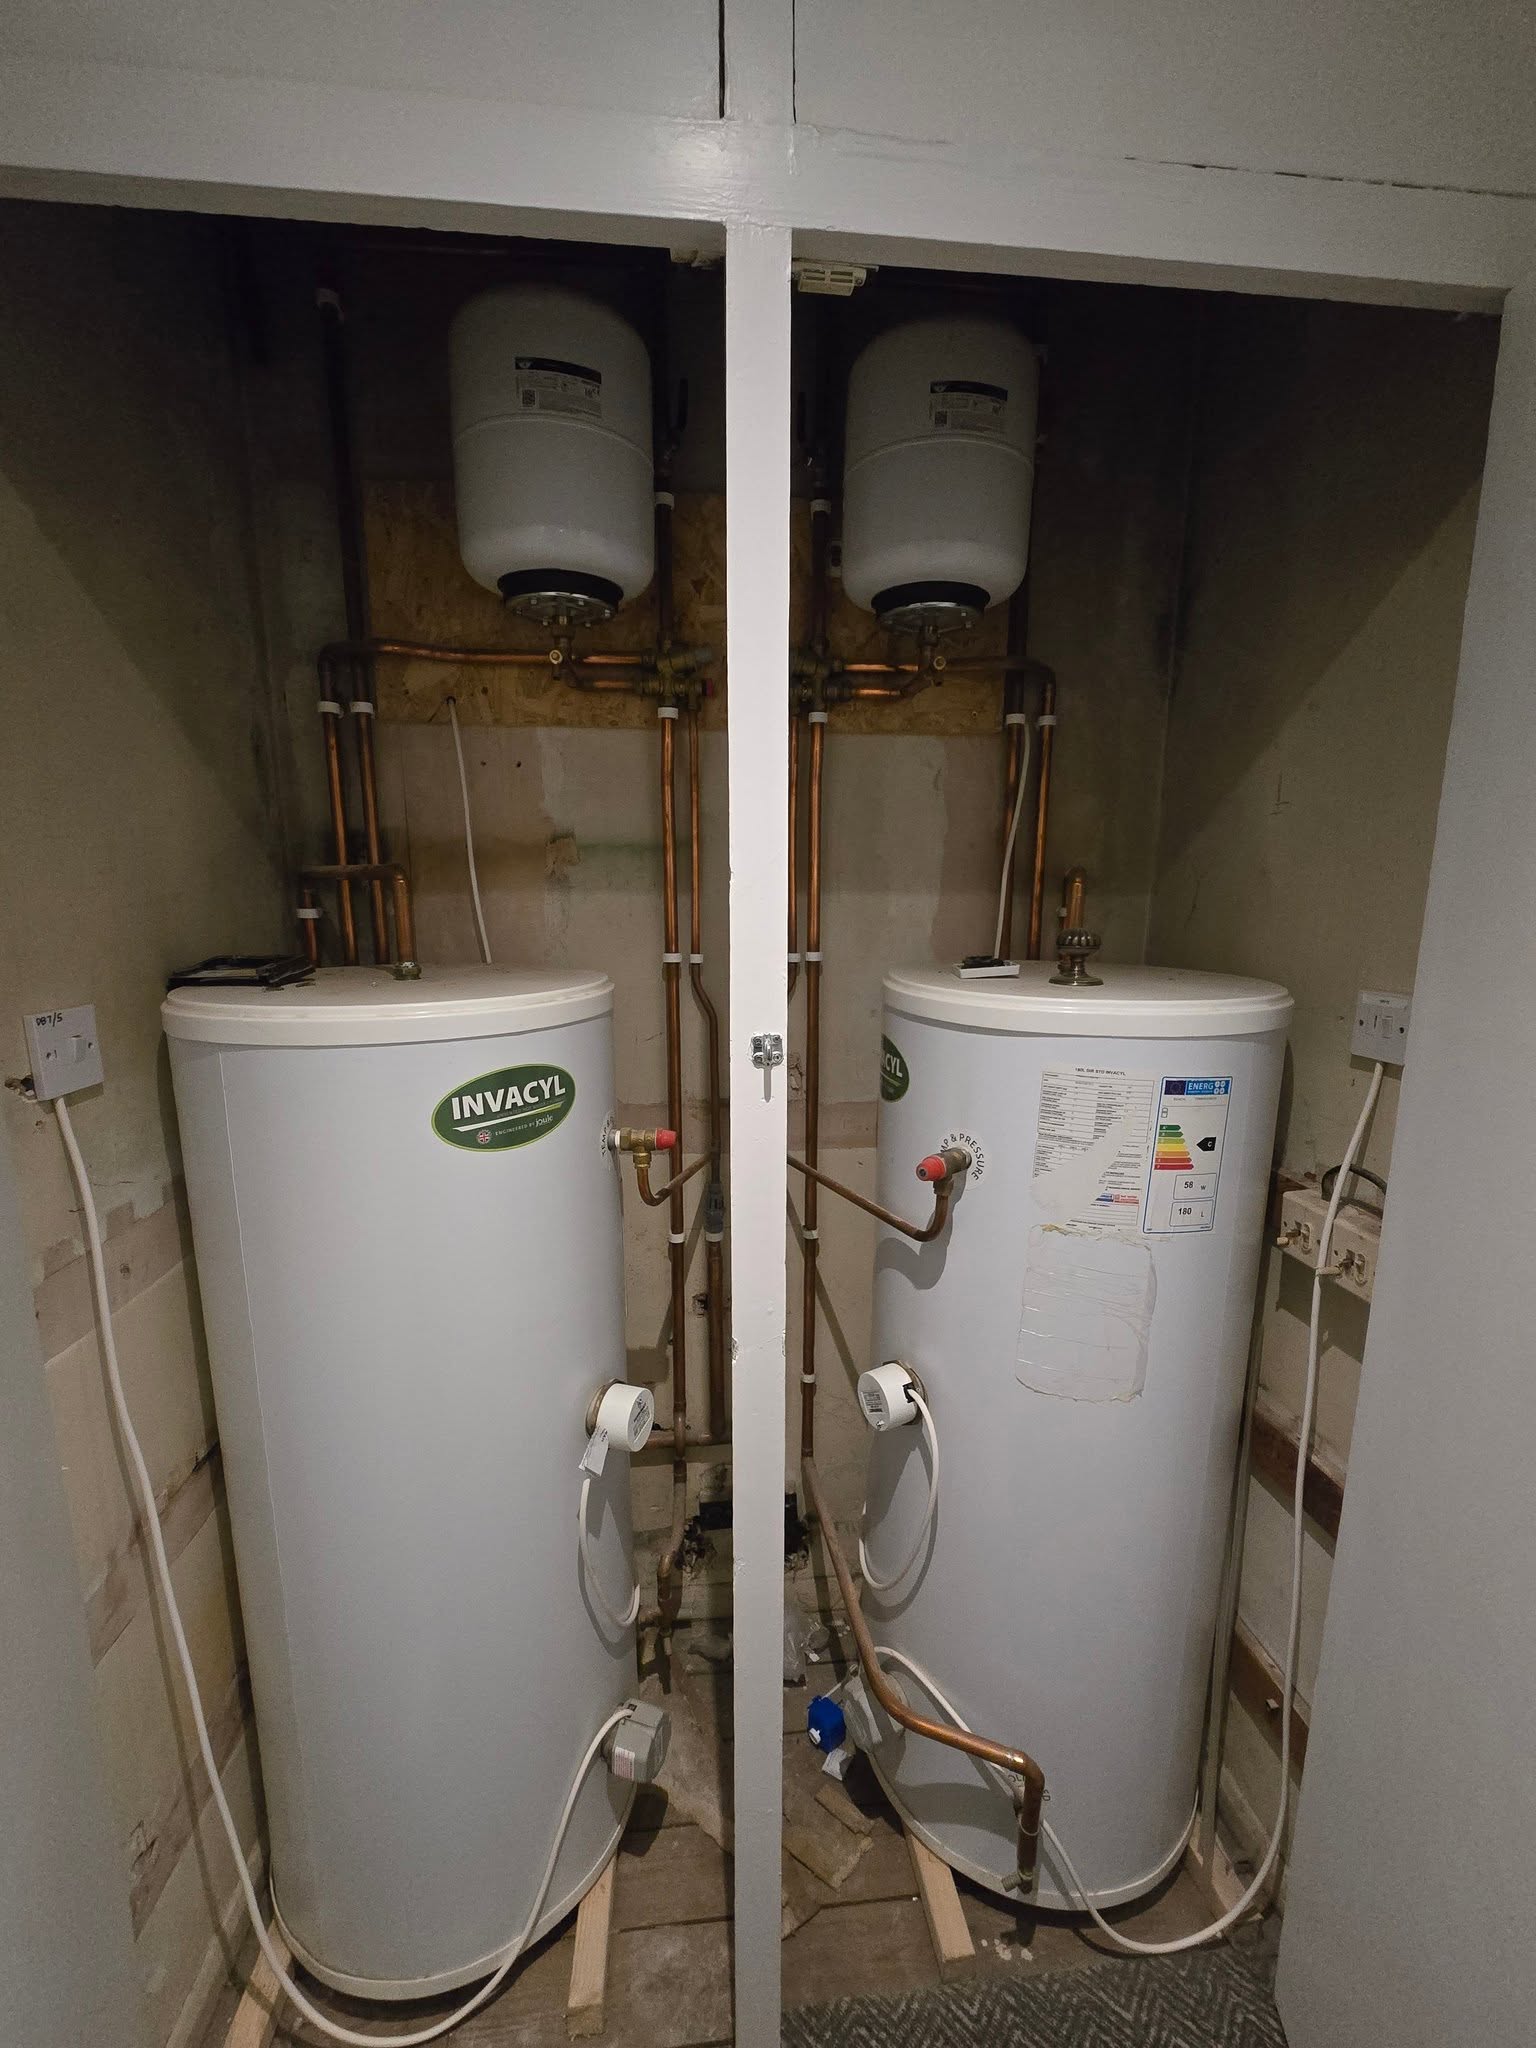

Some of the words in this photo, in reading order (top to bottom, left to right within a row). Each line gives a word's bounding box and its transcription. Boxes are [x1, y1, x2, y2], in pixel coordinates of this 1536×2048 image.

[1188, 1082, 1214, 1090] ENERG
[452, 1075, 565, 1120] INVACYL
[496, 1124, 527, 1136] ENGINEERED
[950, 1133, 957, 1142] &
[959, 1133, 985, 1181] PRESSURE
[1184, 1181, 1194, 1189] 58
